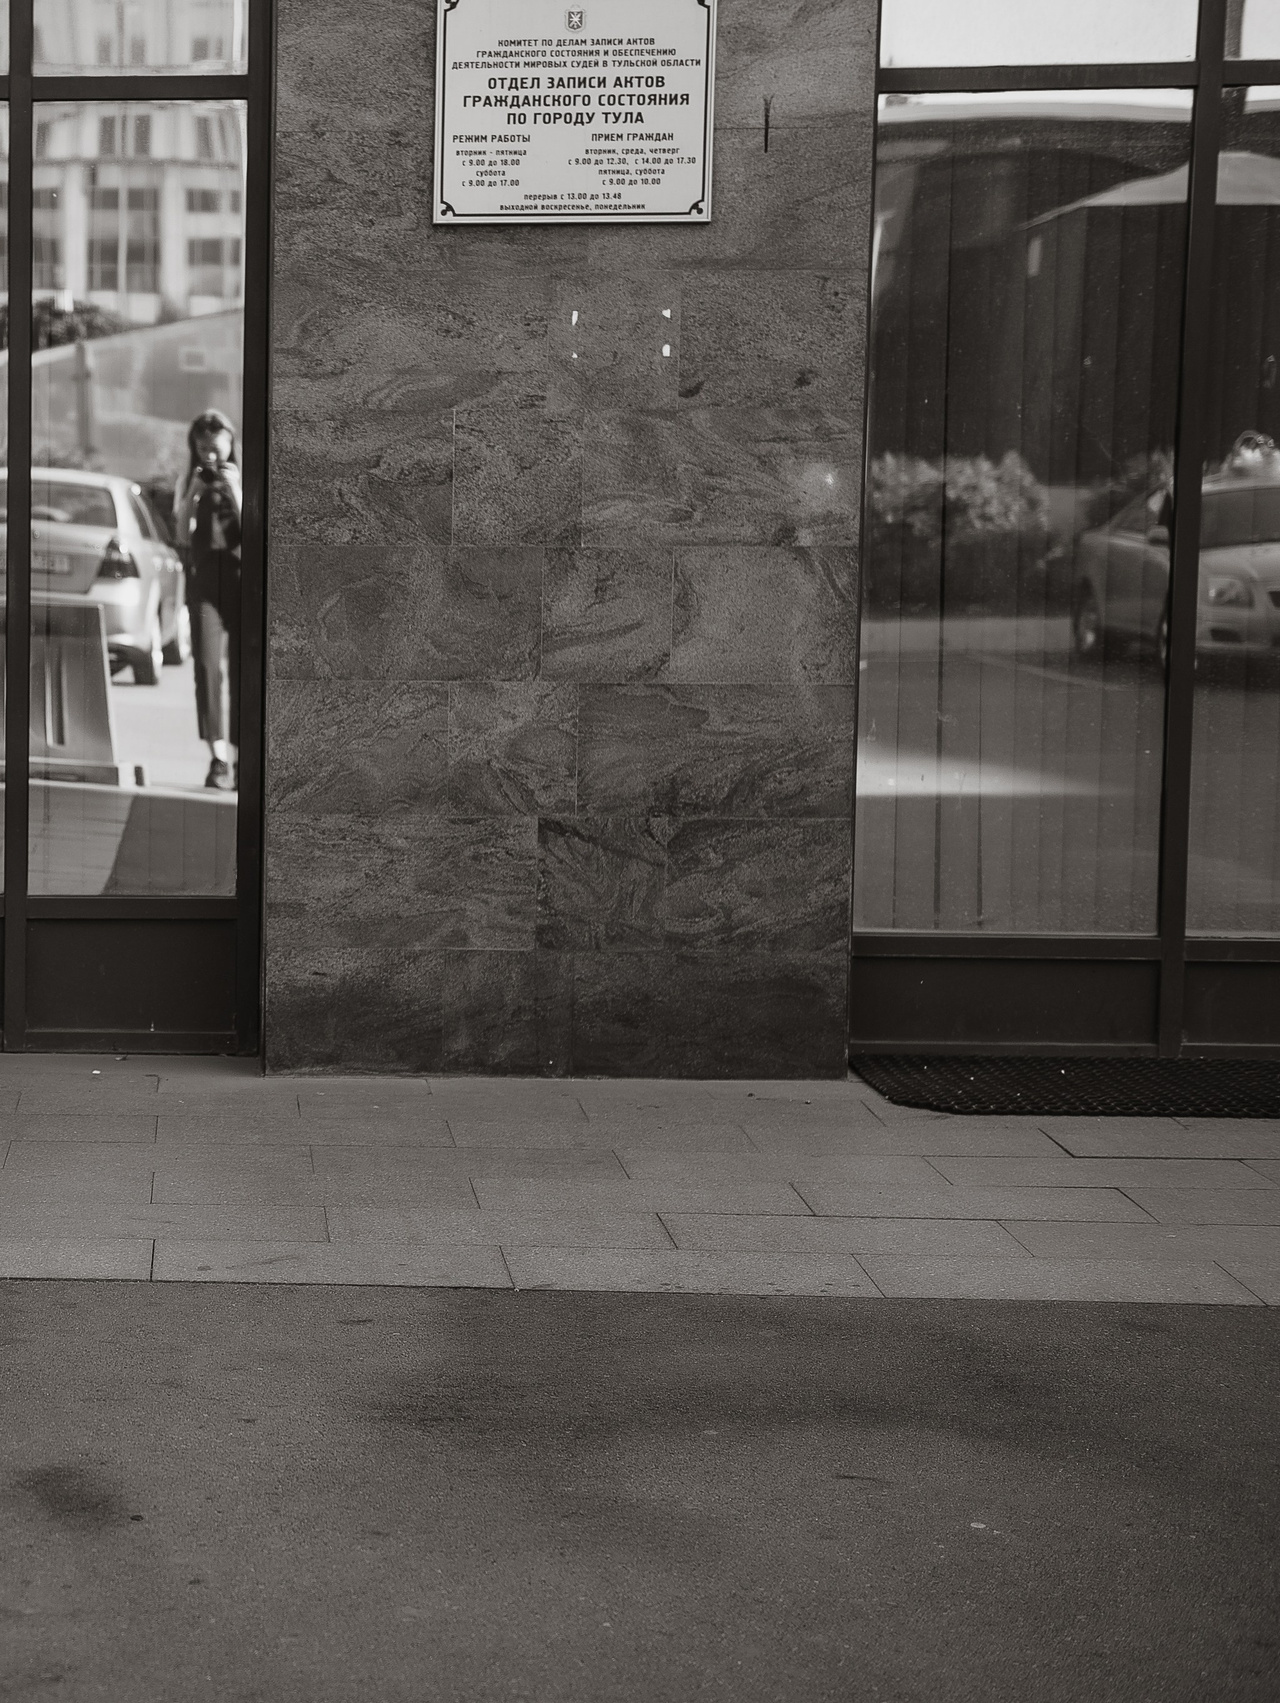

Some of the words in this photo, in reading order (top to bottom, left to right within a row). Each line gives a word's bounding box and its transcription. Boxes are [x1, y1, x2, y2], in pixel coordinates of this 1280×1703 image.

[498, 39, 538, 47] КОМИТЕТ
[541, 39, 553, 47] ПО
[556, 39, 587, 47] ДЕЛАМ
[590, 38, 623, 46] ЗАПИСИ
[626, 38, 655, 46] АКТОВ
[476, 50, 547, 58] ГРАЖДАНСКОГО
[550, 49, 600, 57] СОСТОЯНИЯ
[612, 48, 676, 56] ОБЕСПЕЧЕНИЮ
[452, 61, 520, 70] ДЕЯТЕЛЬНОСТИ
[523, 60, 567, 68] МИРОВЫХ
[571, 59, 599, 69] СУДЕЙ
[612, 58, 658, 67] ТУЛЬСКОЙ
[661, 59, 701, 67] ОБЛАСТИ
[488, 77, 540, 91] ОТДЕЛ
[547, 76, 607, 89] ЗАПИСИ
[613, 76, 665, 88] АКТОВ
[463, 94, 591, 109] ГРАЖДАНСКОГО
[598, 93, 690, 106] СОСТОЯНИЯ
[507, 113, 527, 125] ПО
[534, 112, 595, 126] ГОРОДУ
[602, 112, 644, 124] ТУЛА
[453, 135, 488, 143] РЕЖИМ
[491, 134, 531, 143] РАБОТЫ
[591, 133, 623, 142] ПРИЕМ
[627, 132, 674, 142] ГРАЖДАН
[649, 147, 680, 155] четверг
[607, 157, 629, 166] 12.30,
[641, 157, 662, 165] 14.00
[598, 168, 632, 176] пятница,
[635, 168, 665, 176] суббота
[500, 179, 520, 187] 17.00
[609, 178, 626, 186] 9.00
[524, 193, 558, 201] перерыв
[602, 192, 622, 200] 13.48
[500, 203, 538, 211] выходной
[541, 203, 592, 211] воскресенье,
